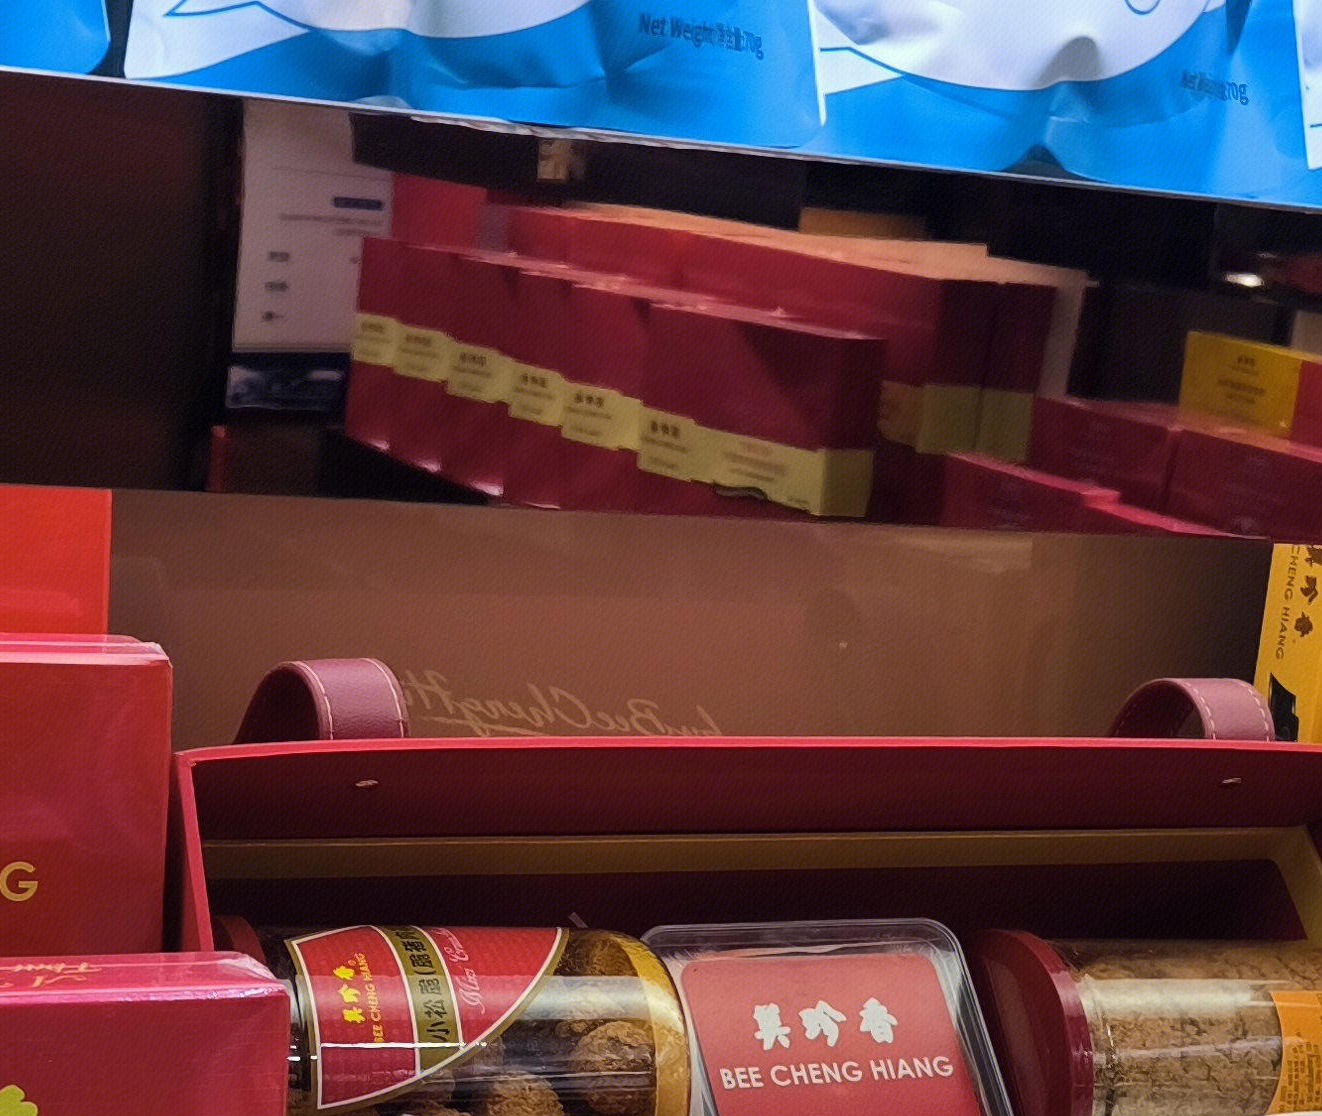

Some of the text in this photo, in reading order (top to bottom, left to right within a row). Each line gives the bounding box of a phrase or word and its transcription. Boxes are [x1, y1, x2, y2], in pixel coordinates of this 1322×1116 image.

[753, 997, 898, 1051] 美珍香
[719, 1056, 954, 1091] BEE CHENG HIANG
